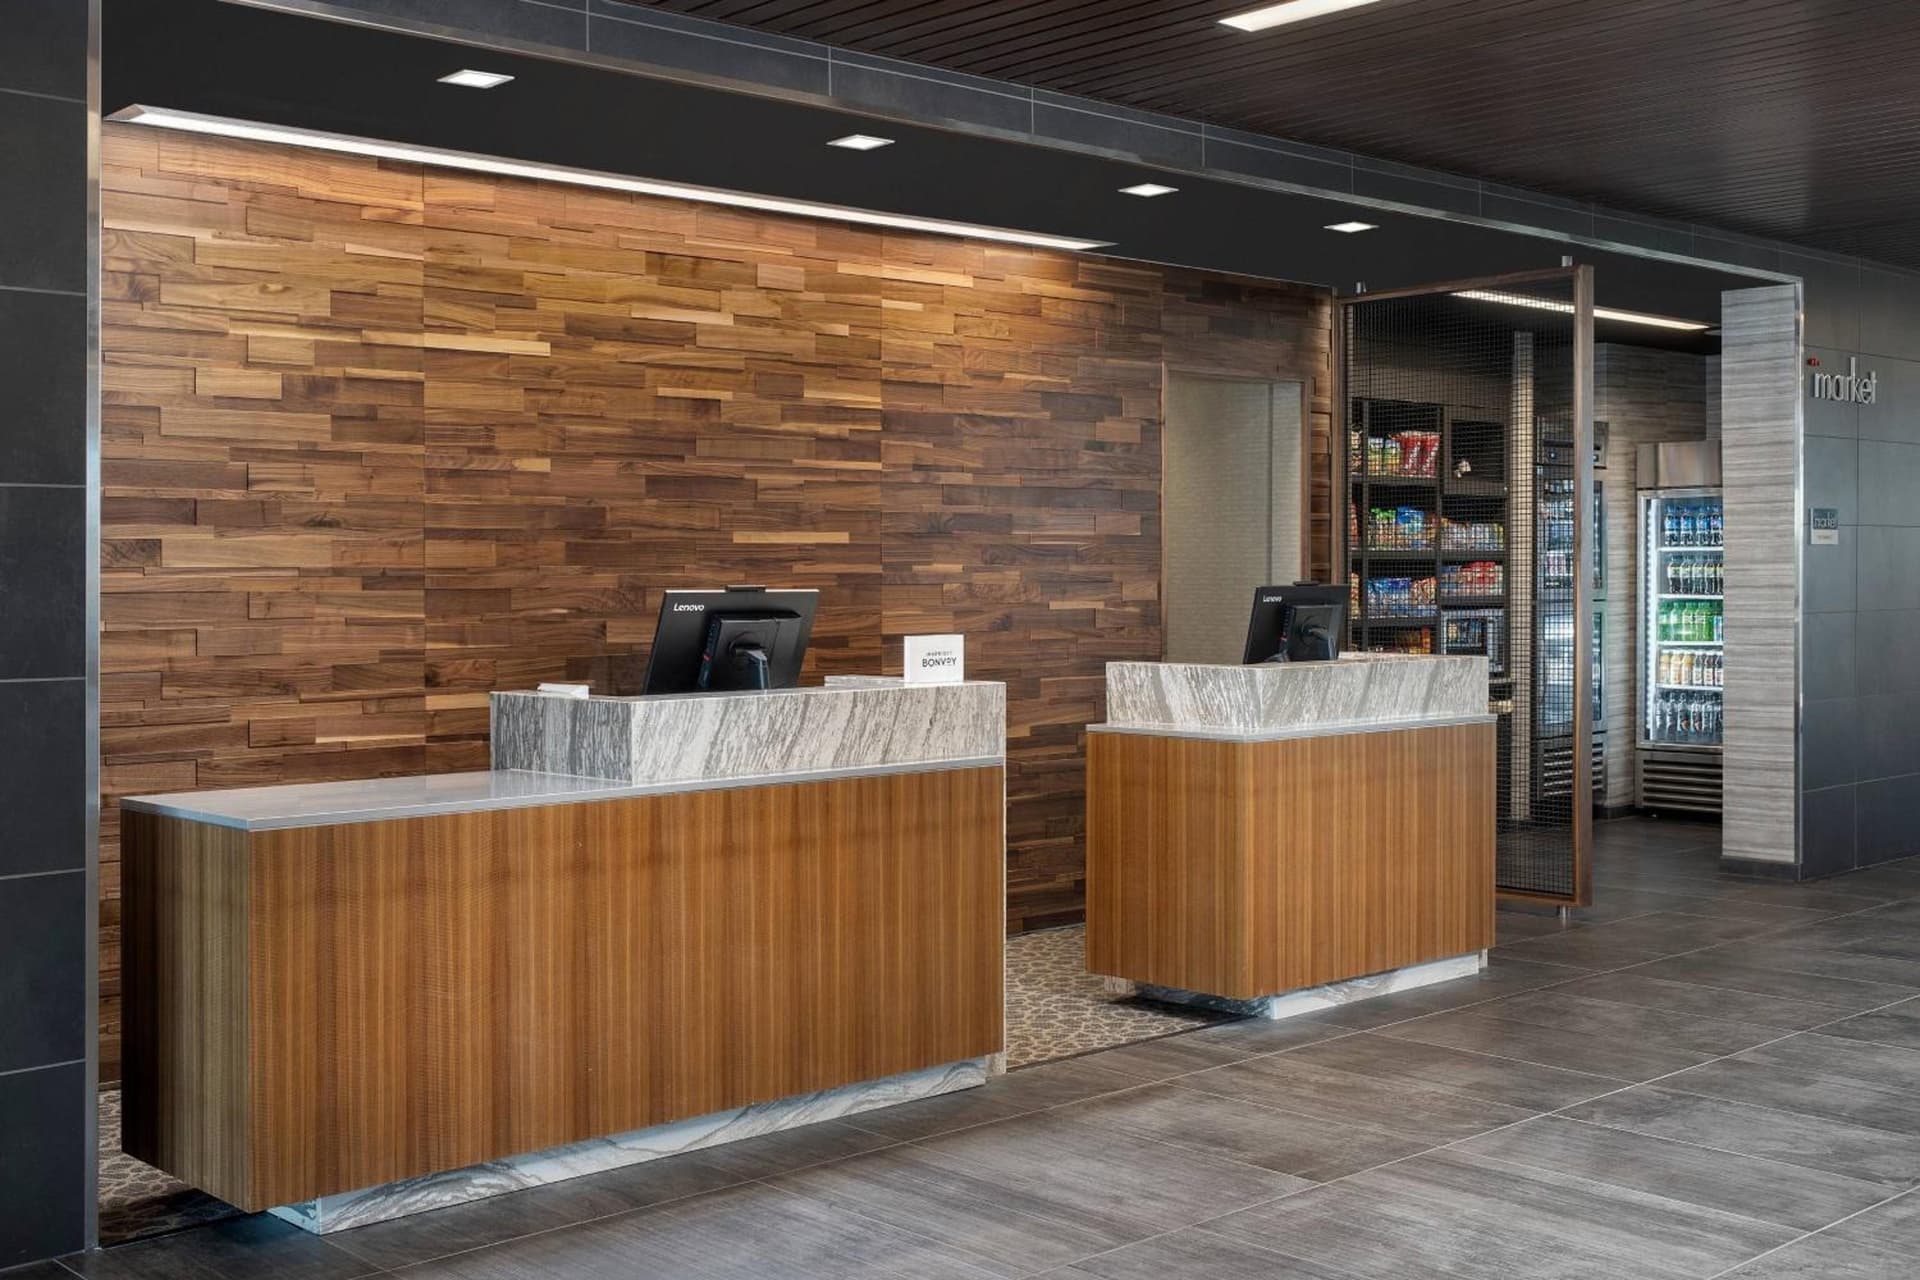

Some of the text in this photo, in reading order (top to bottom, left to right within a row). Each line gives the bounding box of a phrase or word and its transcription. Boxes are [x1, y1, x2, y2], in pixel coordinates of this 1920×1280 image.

[1814, 357, 1877, 404] market
[674, 603, 704, 612] Lenovo
[922, 657, 956, 668] BONVOY
